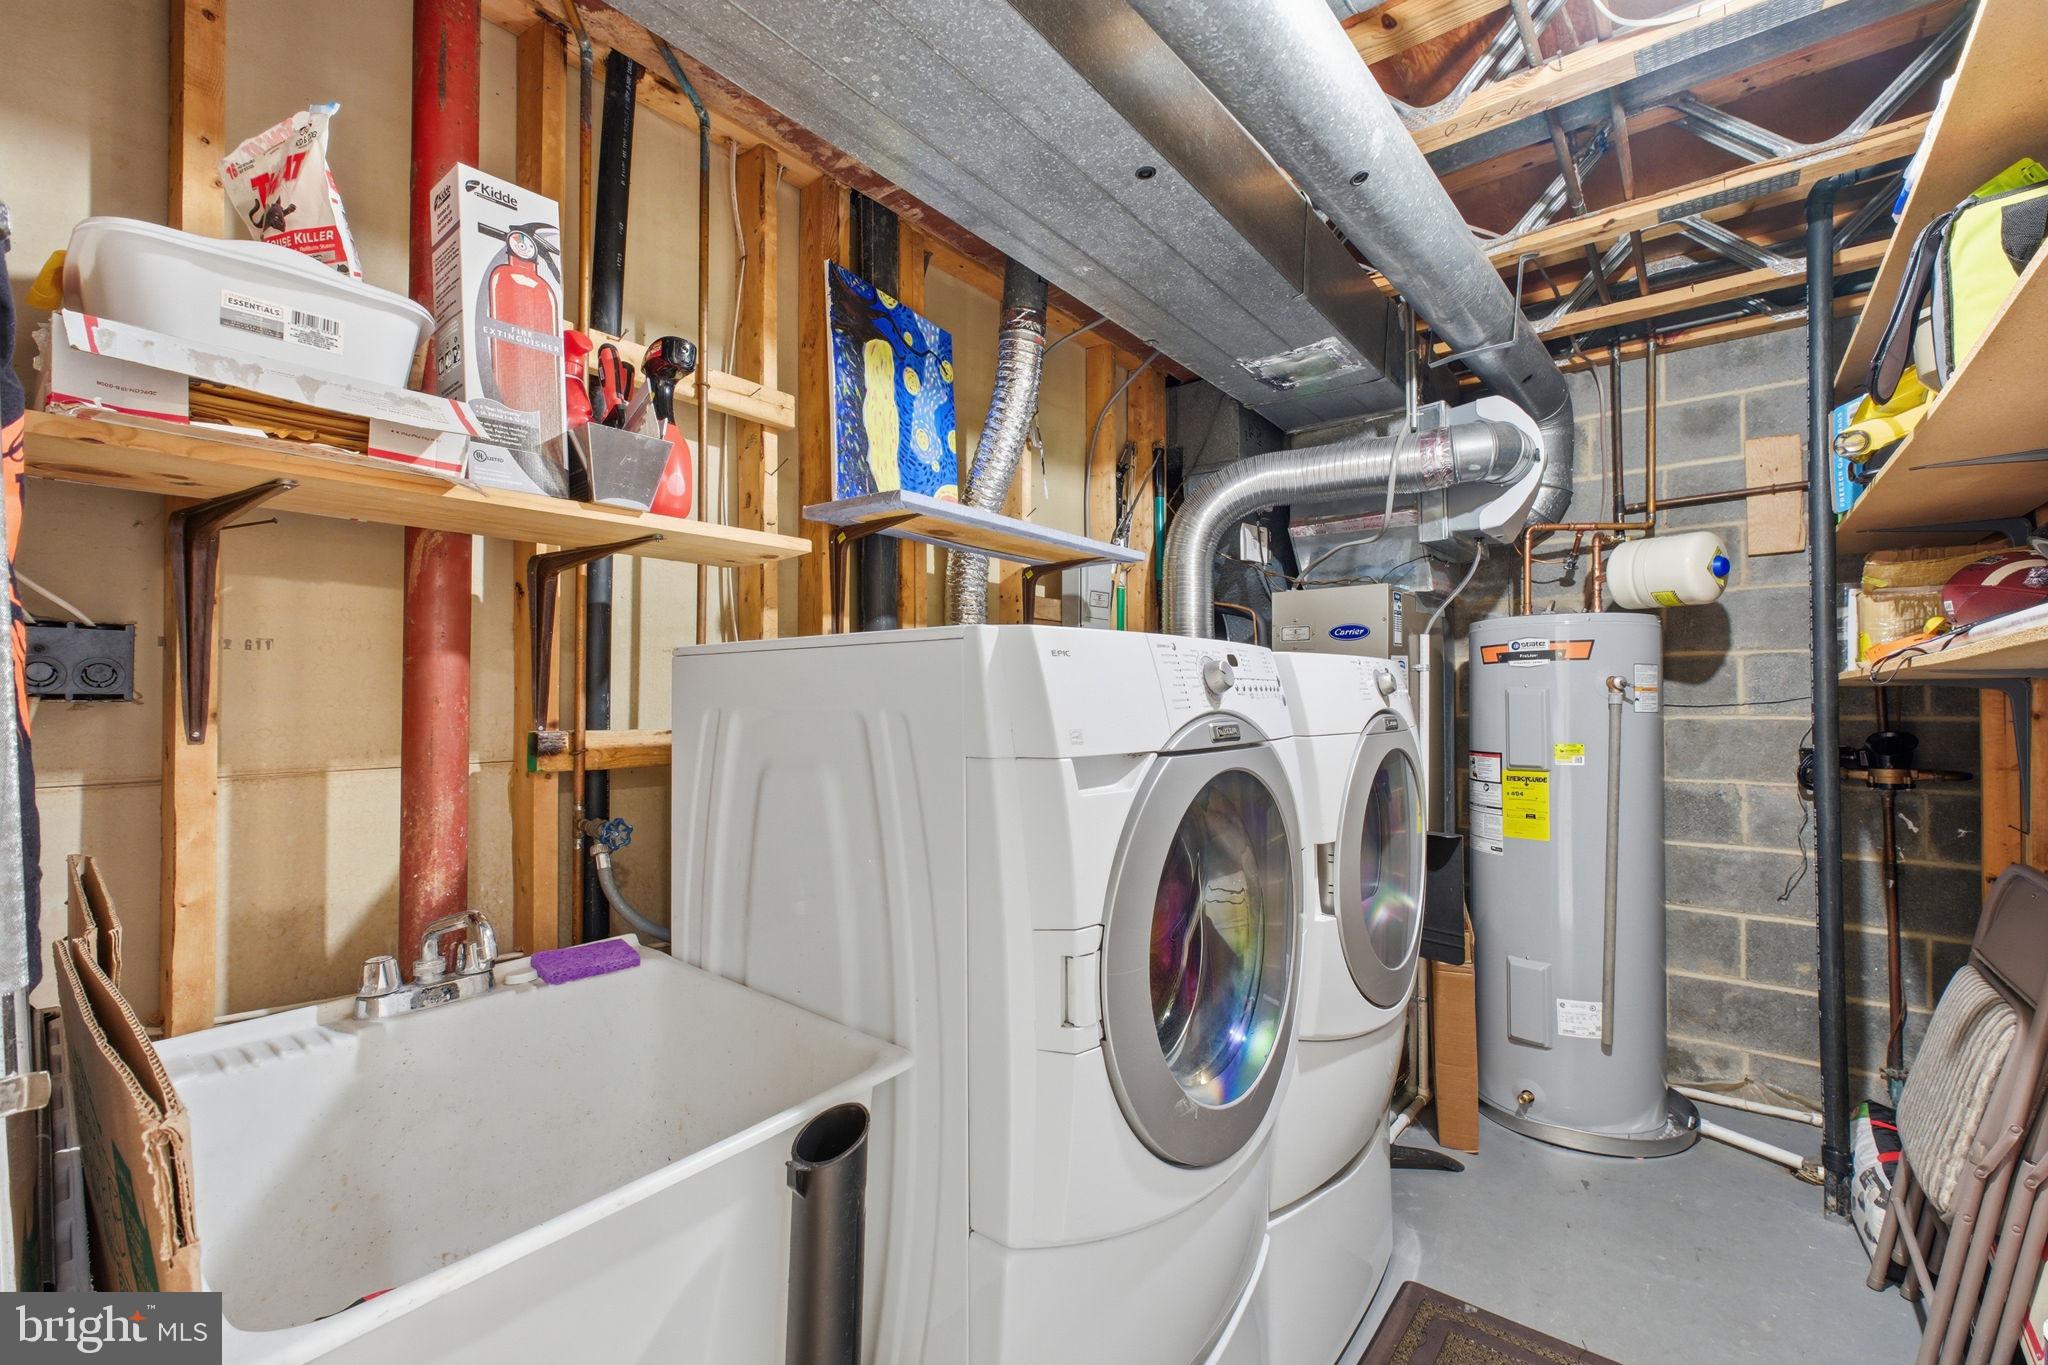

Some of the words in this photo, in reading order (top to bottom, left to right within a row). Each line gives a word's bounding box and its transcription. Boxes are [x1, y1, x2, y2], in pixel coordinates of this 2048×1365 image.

[481, 183, 518, 207] Kidde
[293, 229, 335, 244] KILLER
[227, 297, 281, 316] ESSENTIALS
[511, 326, 533, 338] FIRE
[483, 325, 560, 353] EXTINGUISHER
[1334, 628, 1365, 637] Carrier
[1520, 640, 1546, 648] state
[1050, 649, 1071, 657] EPIC
